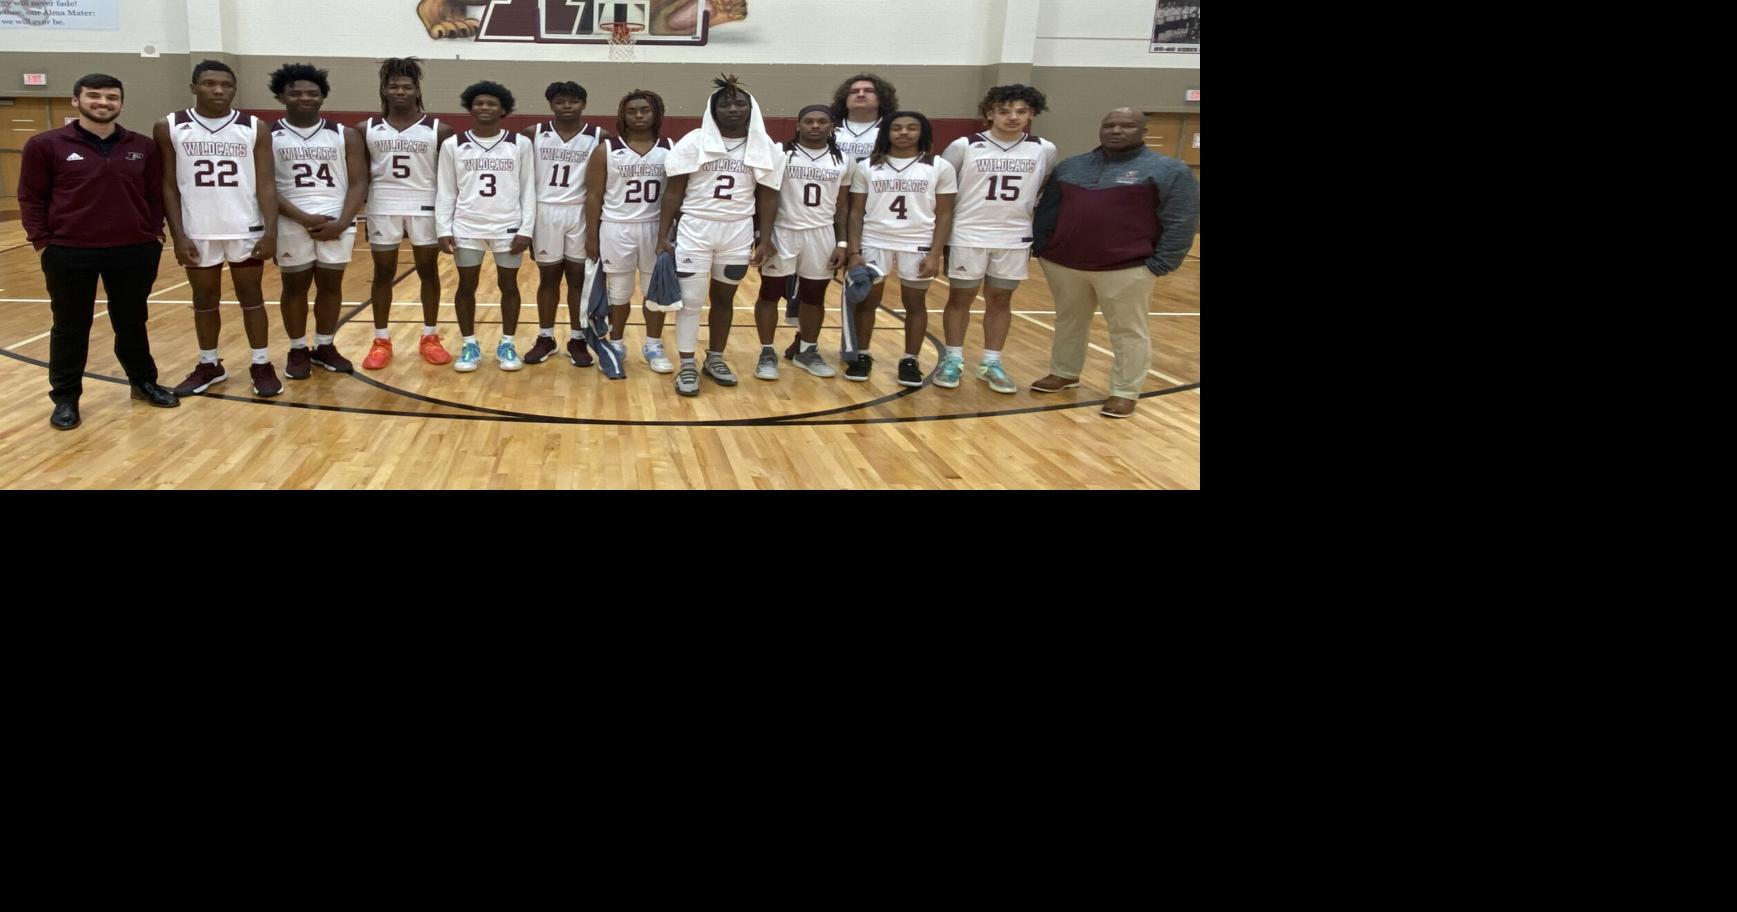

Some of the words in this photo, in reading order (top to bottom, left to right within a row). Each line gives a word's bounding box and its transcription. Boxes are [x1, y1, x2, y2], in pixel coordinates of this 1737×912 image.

[182, 142, 248, 157] WILDCATS
[279, 146, 338, 161] WILDCATS
[375, 140, 429, 153] WILDCATS
[194, 159, 239, 187] 22
[292, 163, 336, 187] 24
[392, 155, 411, 179] 5
[463, 158, 515, 172] WILDCATS
[549, 163, 571, 188] 11
[786, 165, 841, 183] WILDCATS
[976, 158, 1037, 174] WILDCATS
[479, 173, 497, 197] 3
[624, 179, 661, 204] 20
[713, 174, 735, 201] 2
[803, 183, 821, 208] 0
[872, 179, 929, 194] WILDCATS
[985, 175, 1022, 202] 15
[889, 195, 908, 220] 4
